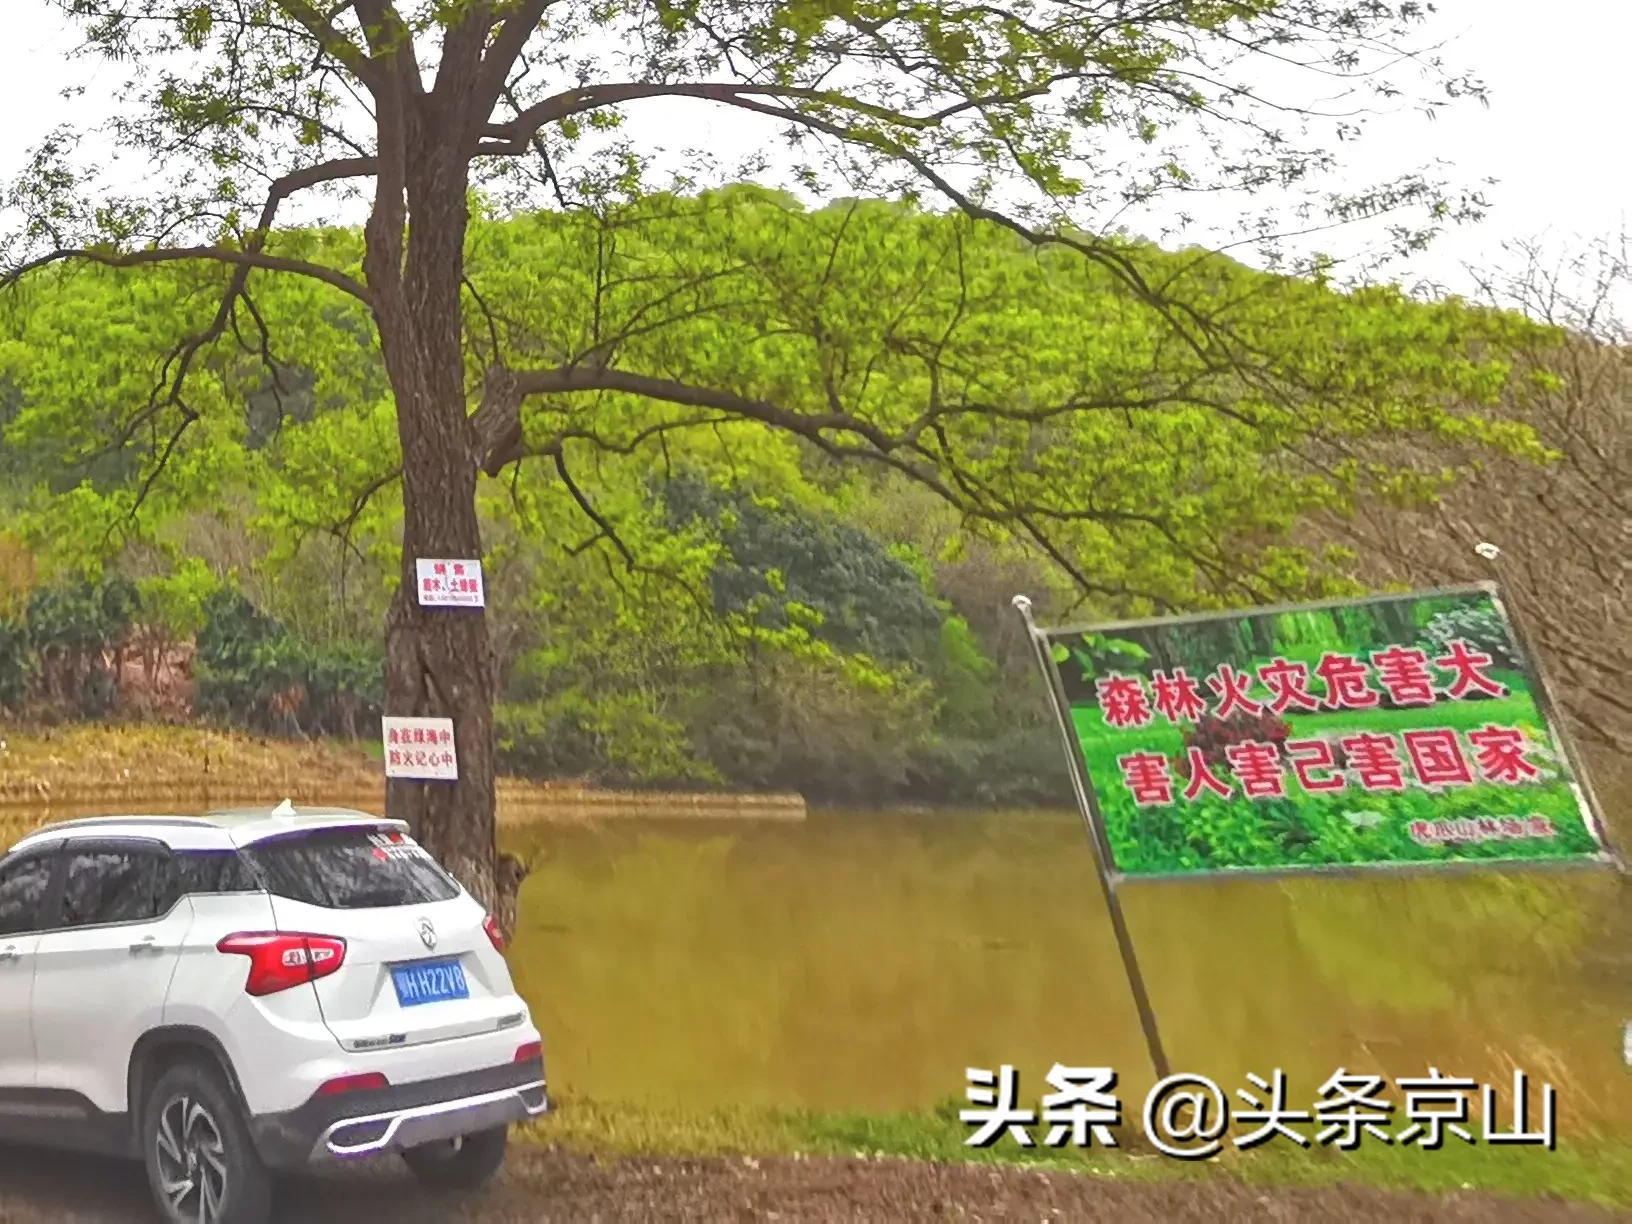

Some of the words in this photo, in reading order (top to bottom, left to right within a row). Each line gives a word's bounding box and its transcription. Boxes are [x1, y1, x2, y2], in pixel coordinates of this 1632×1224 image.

[1096, 640, 1510, 728] 森林火灾危害大
[1119, 725, 1539, 807] 害人害己害国家
